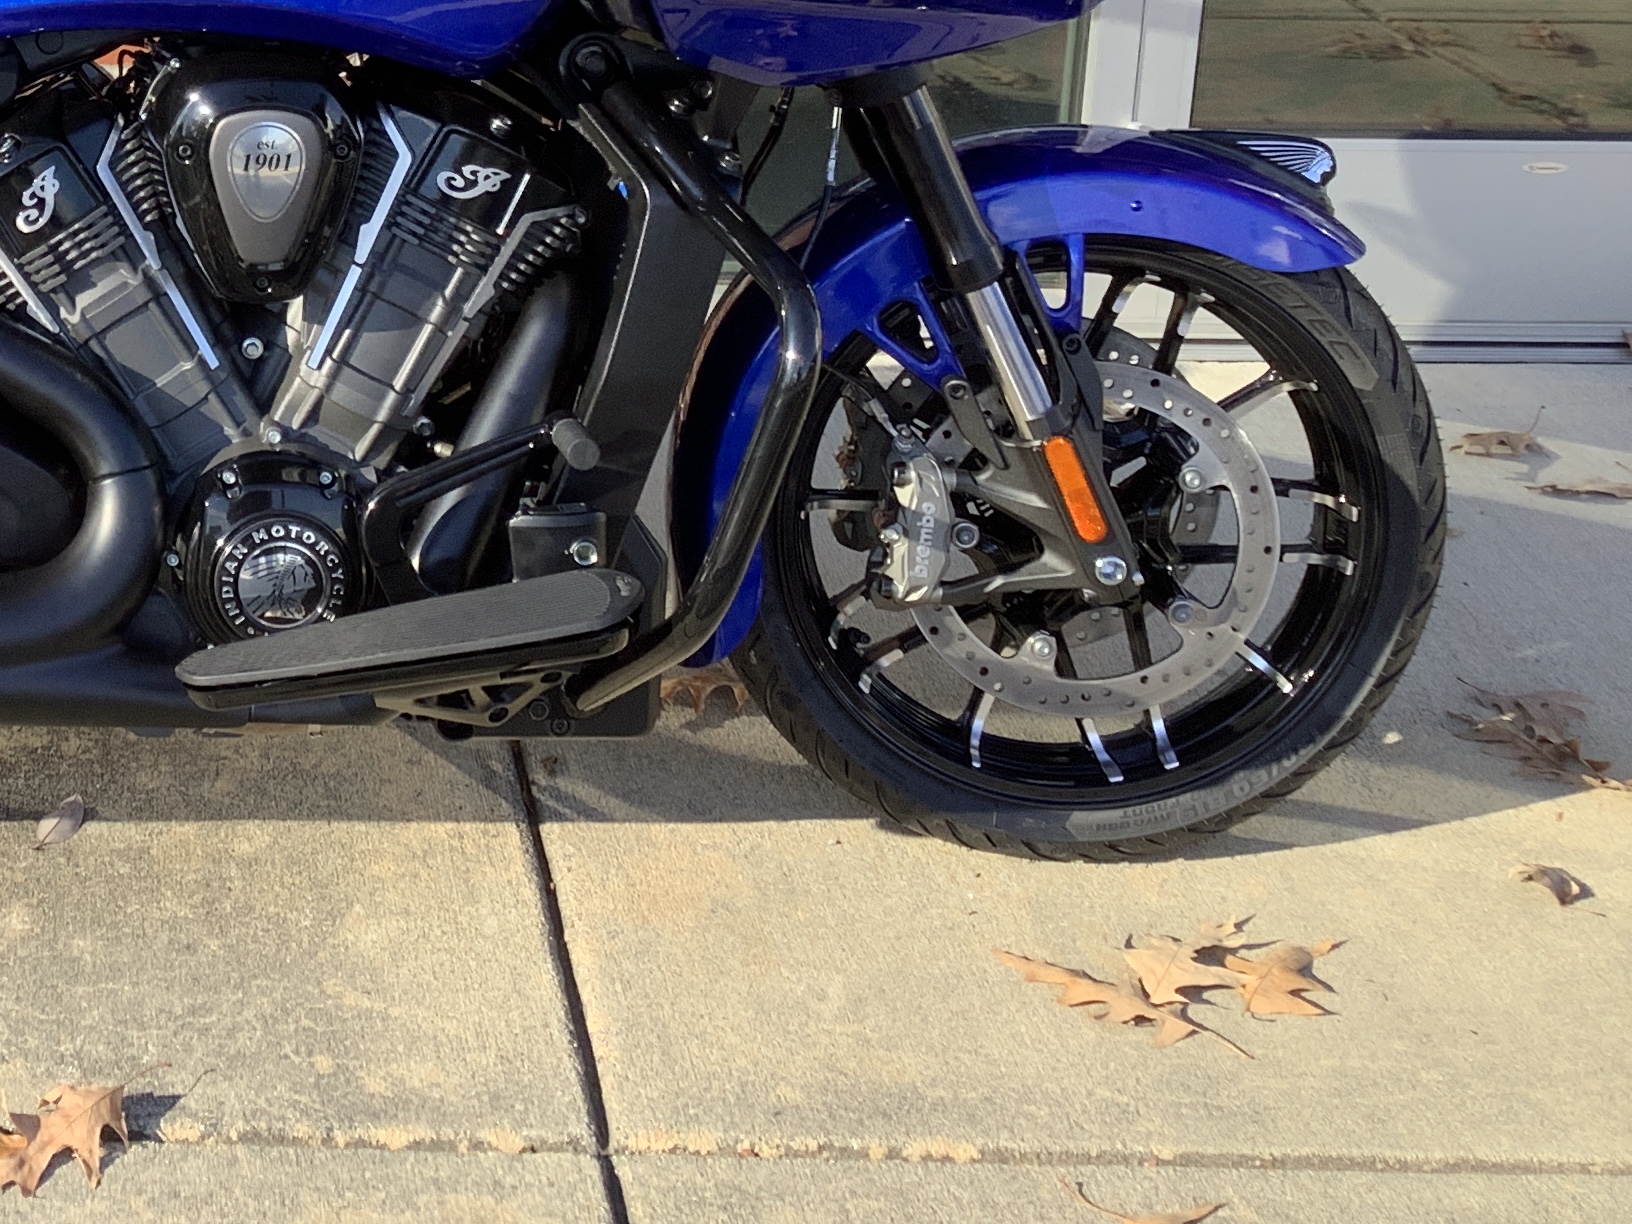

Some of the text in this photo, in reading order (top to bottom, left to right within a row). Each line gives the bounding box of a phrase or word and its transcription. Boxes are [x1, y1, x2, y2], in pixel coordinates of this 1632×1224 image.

[243, 152, 292, 172] 1901
[221, 525, 345, 626] INDIAN MOTORCYCLE
[911, 502, 936, 579] brembo
